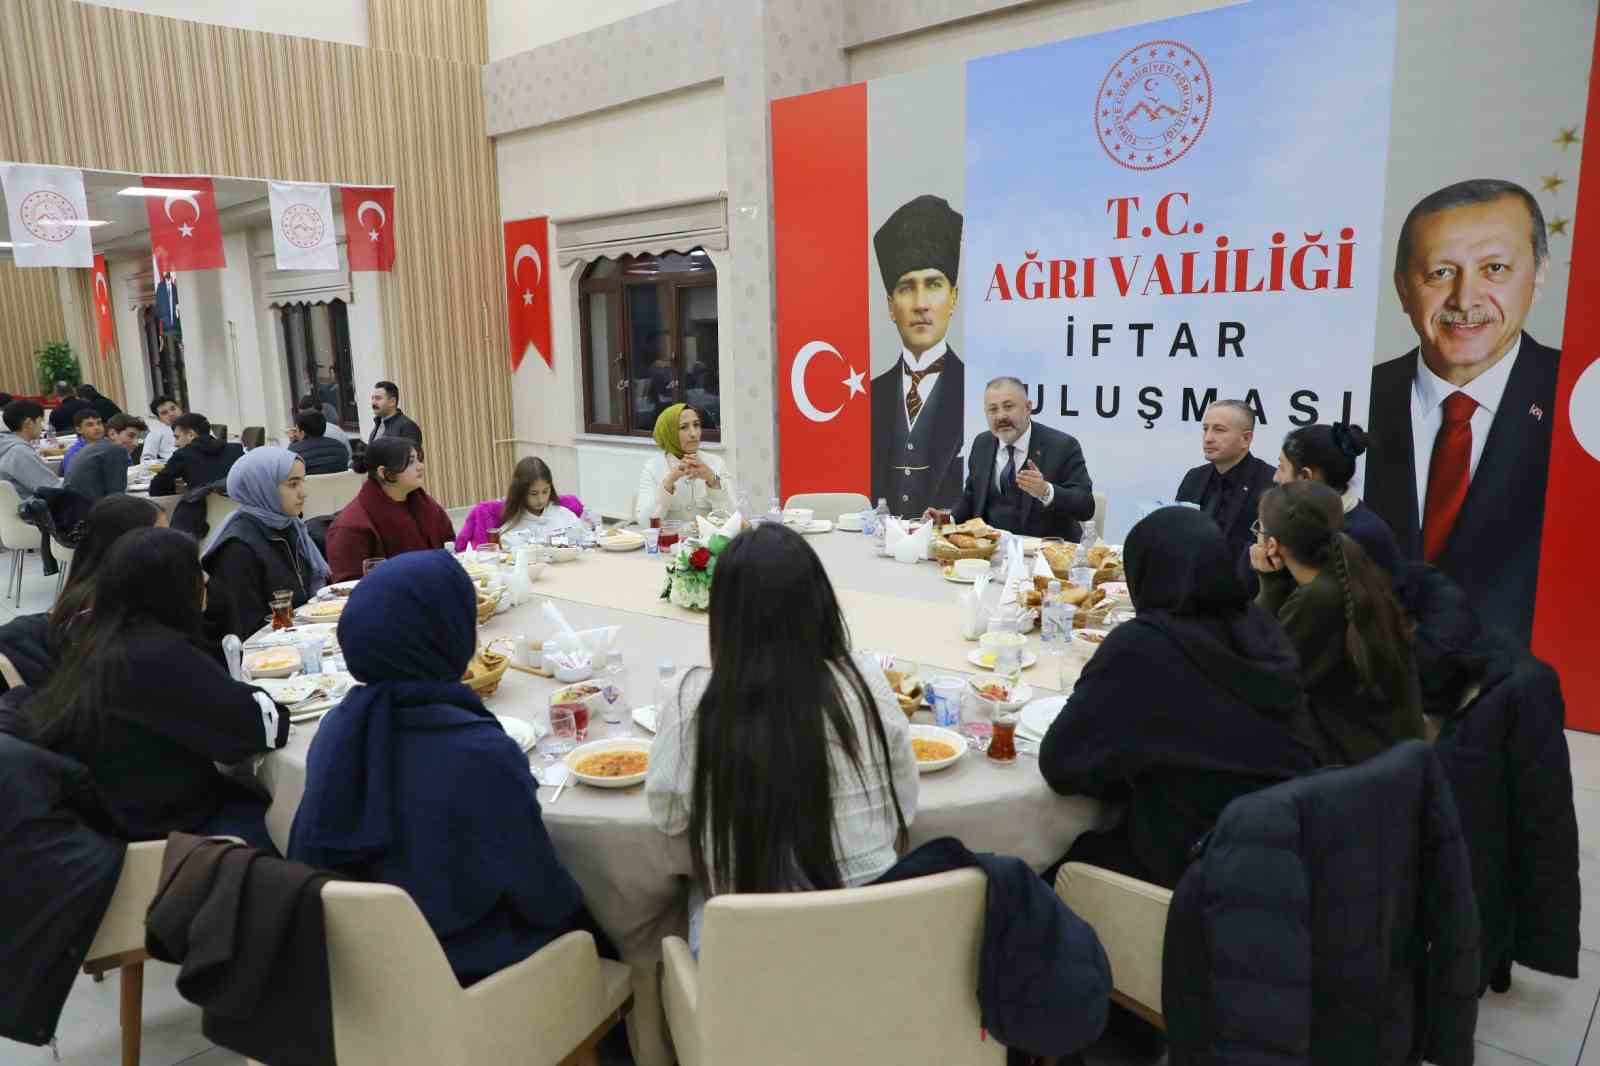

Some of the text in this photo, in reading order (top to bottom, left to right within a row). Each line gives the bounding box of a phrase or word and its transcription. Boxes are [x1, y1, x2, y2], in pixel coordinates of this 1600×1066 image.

[1107, 192, 1204, 240] T.C.
[985, 227, 1358, 302] AĞRI VALİLİĞİ
[1066, 315, 1246, 358] İFTAR
[1022, 383, 1353, 430] ULUŞMASI
